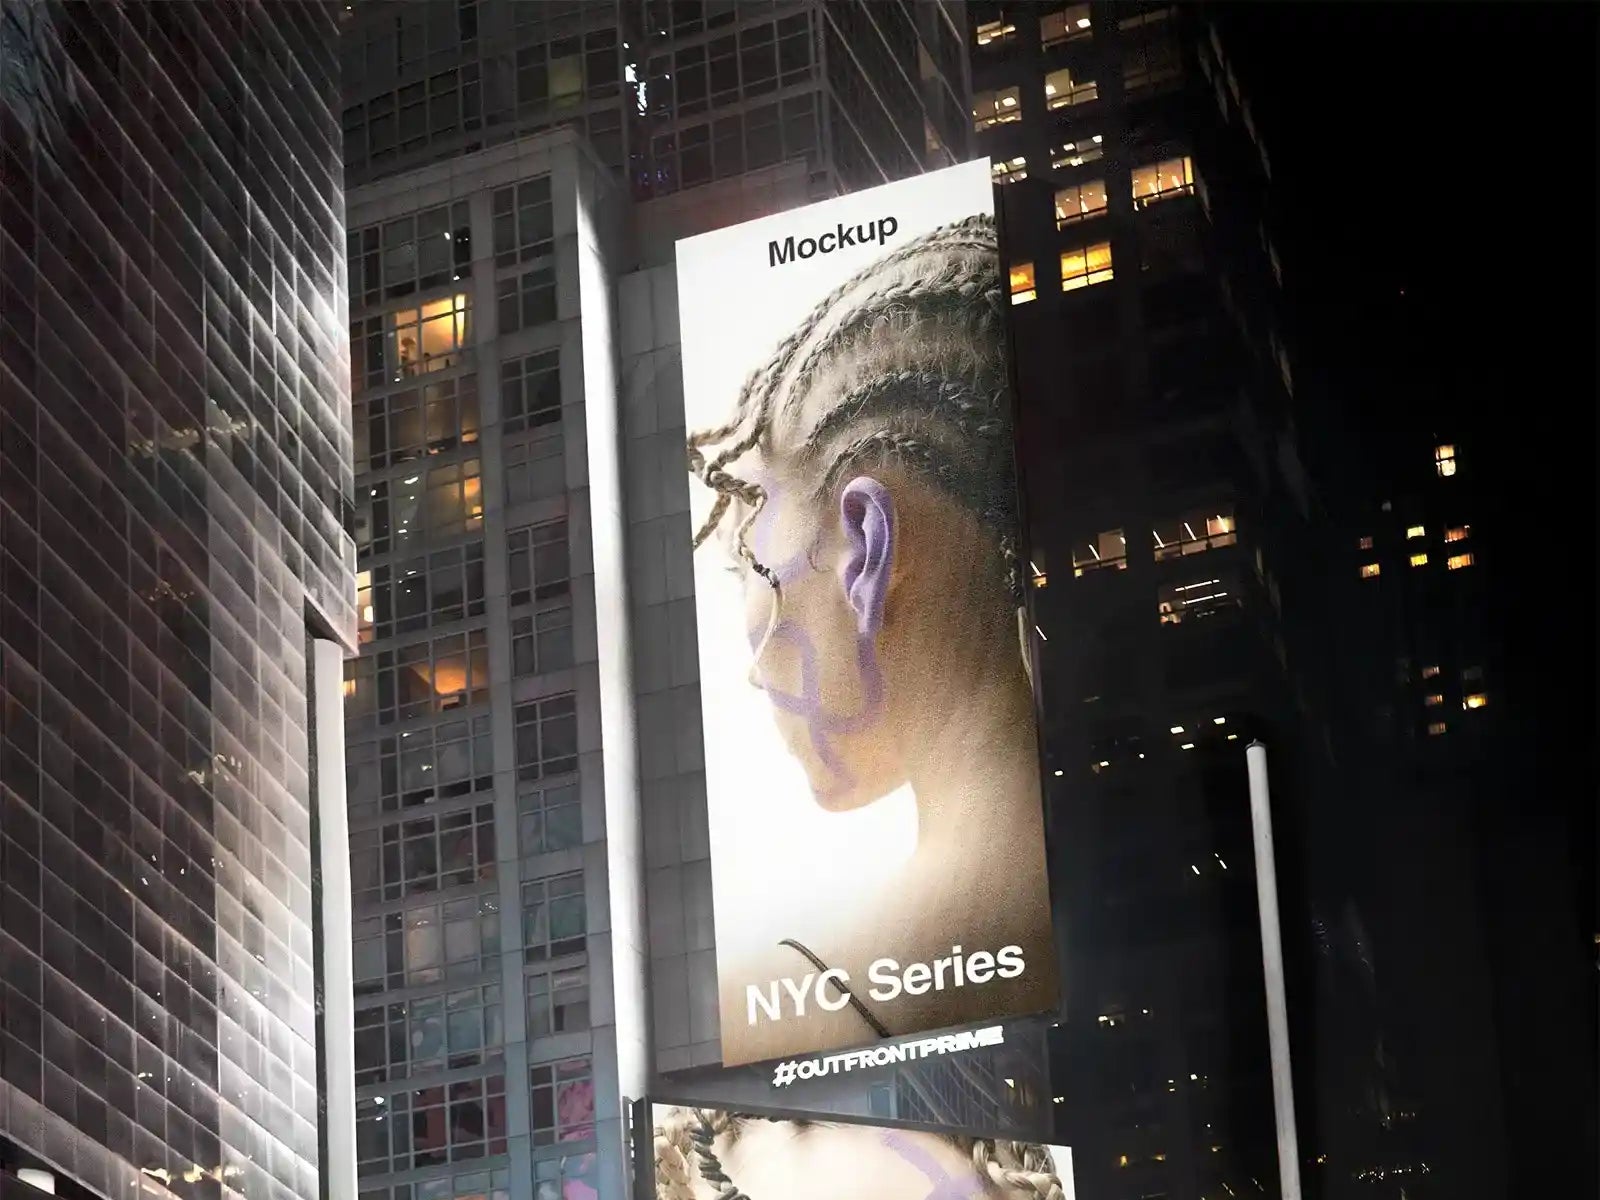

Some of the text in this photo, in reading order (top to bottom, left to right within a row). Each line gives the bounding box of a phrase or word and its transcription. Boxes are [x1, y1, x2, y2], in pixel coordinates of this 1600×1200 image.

[767, 213, 899, 268] Mockup
[746, 945, 1026, 1026] NYC Series
[772, 1025, 1005, 1088] #OUTFRONTPRIME
